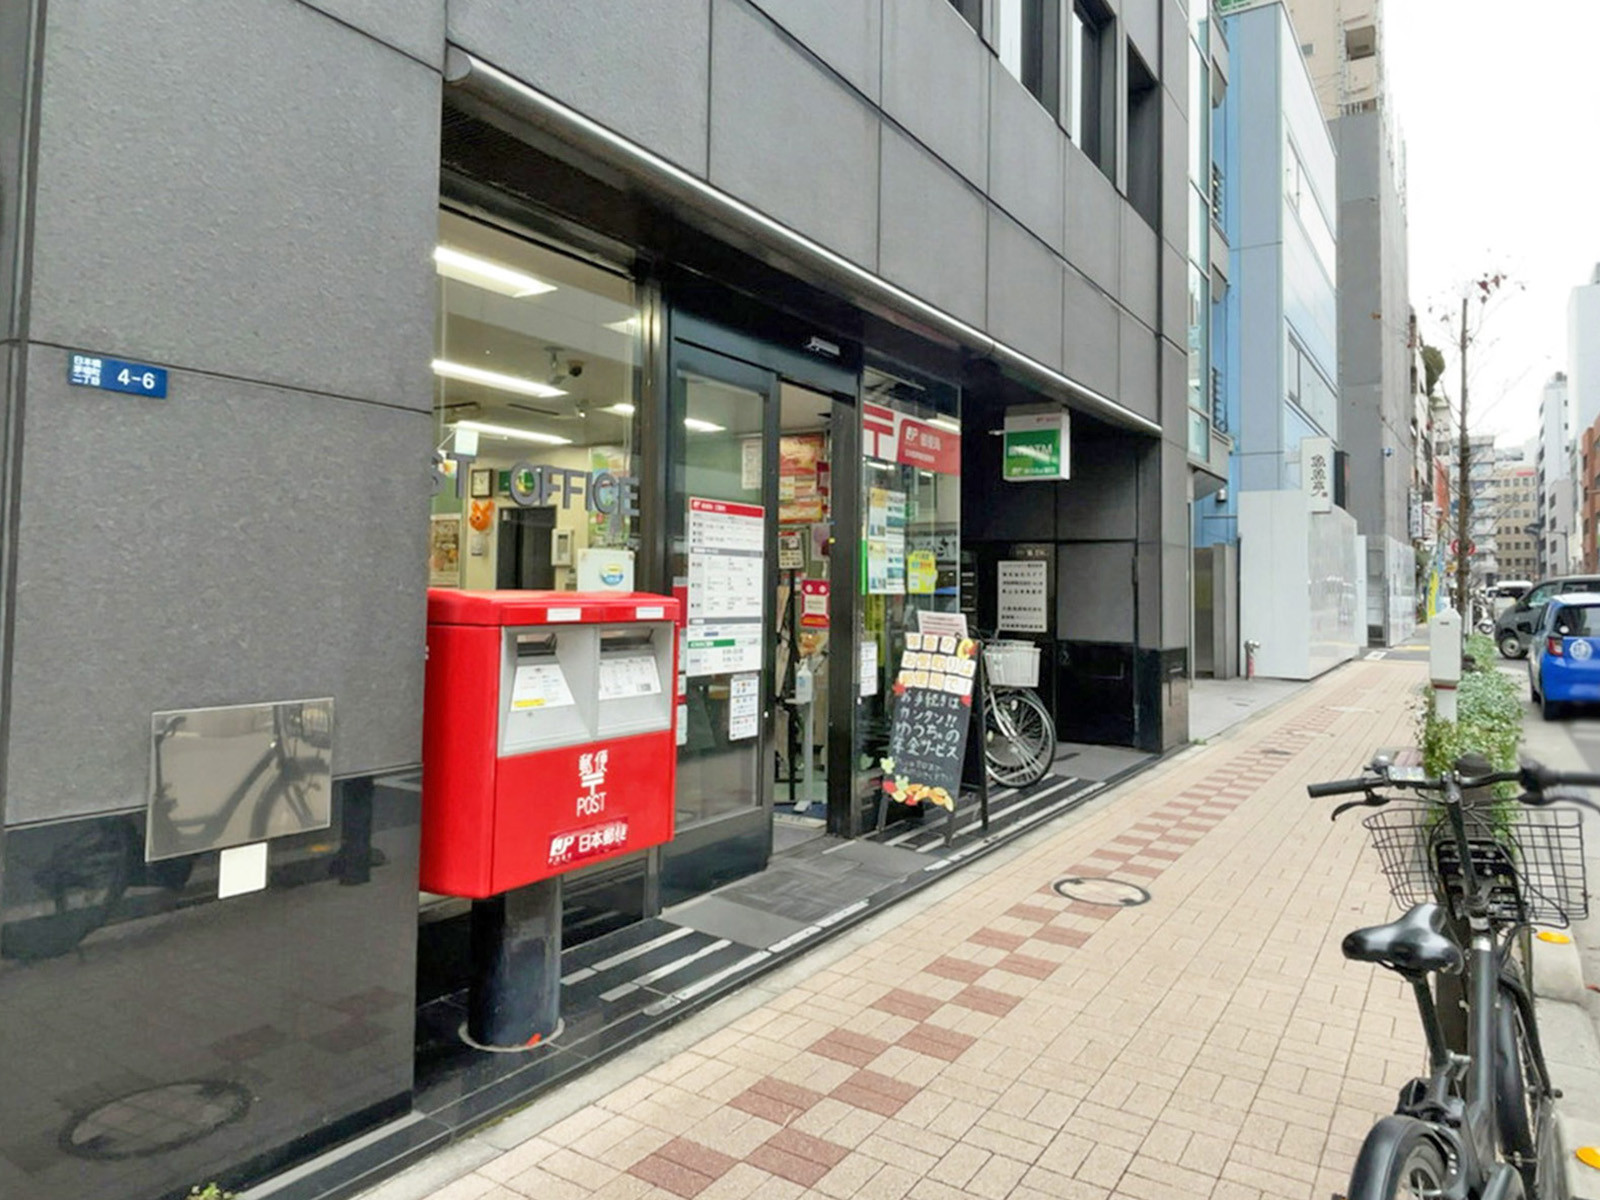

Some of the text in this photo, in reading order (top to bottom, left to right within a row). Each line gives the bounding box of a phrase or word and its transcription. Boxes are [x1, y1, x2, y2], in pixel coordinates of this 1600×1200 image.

[117, 368, 155, 389] 4-6
[509, 461, 640, 517] OFFICE
[576, 792, 607, 817] POST
